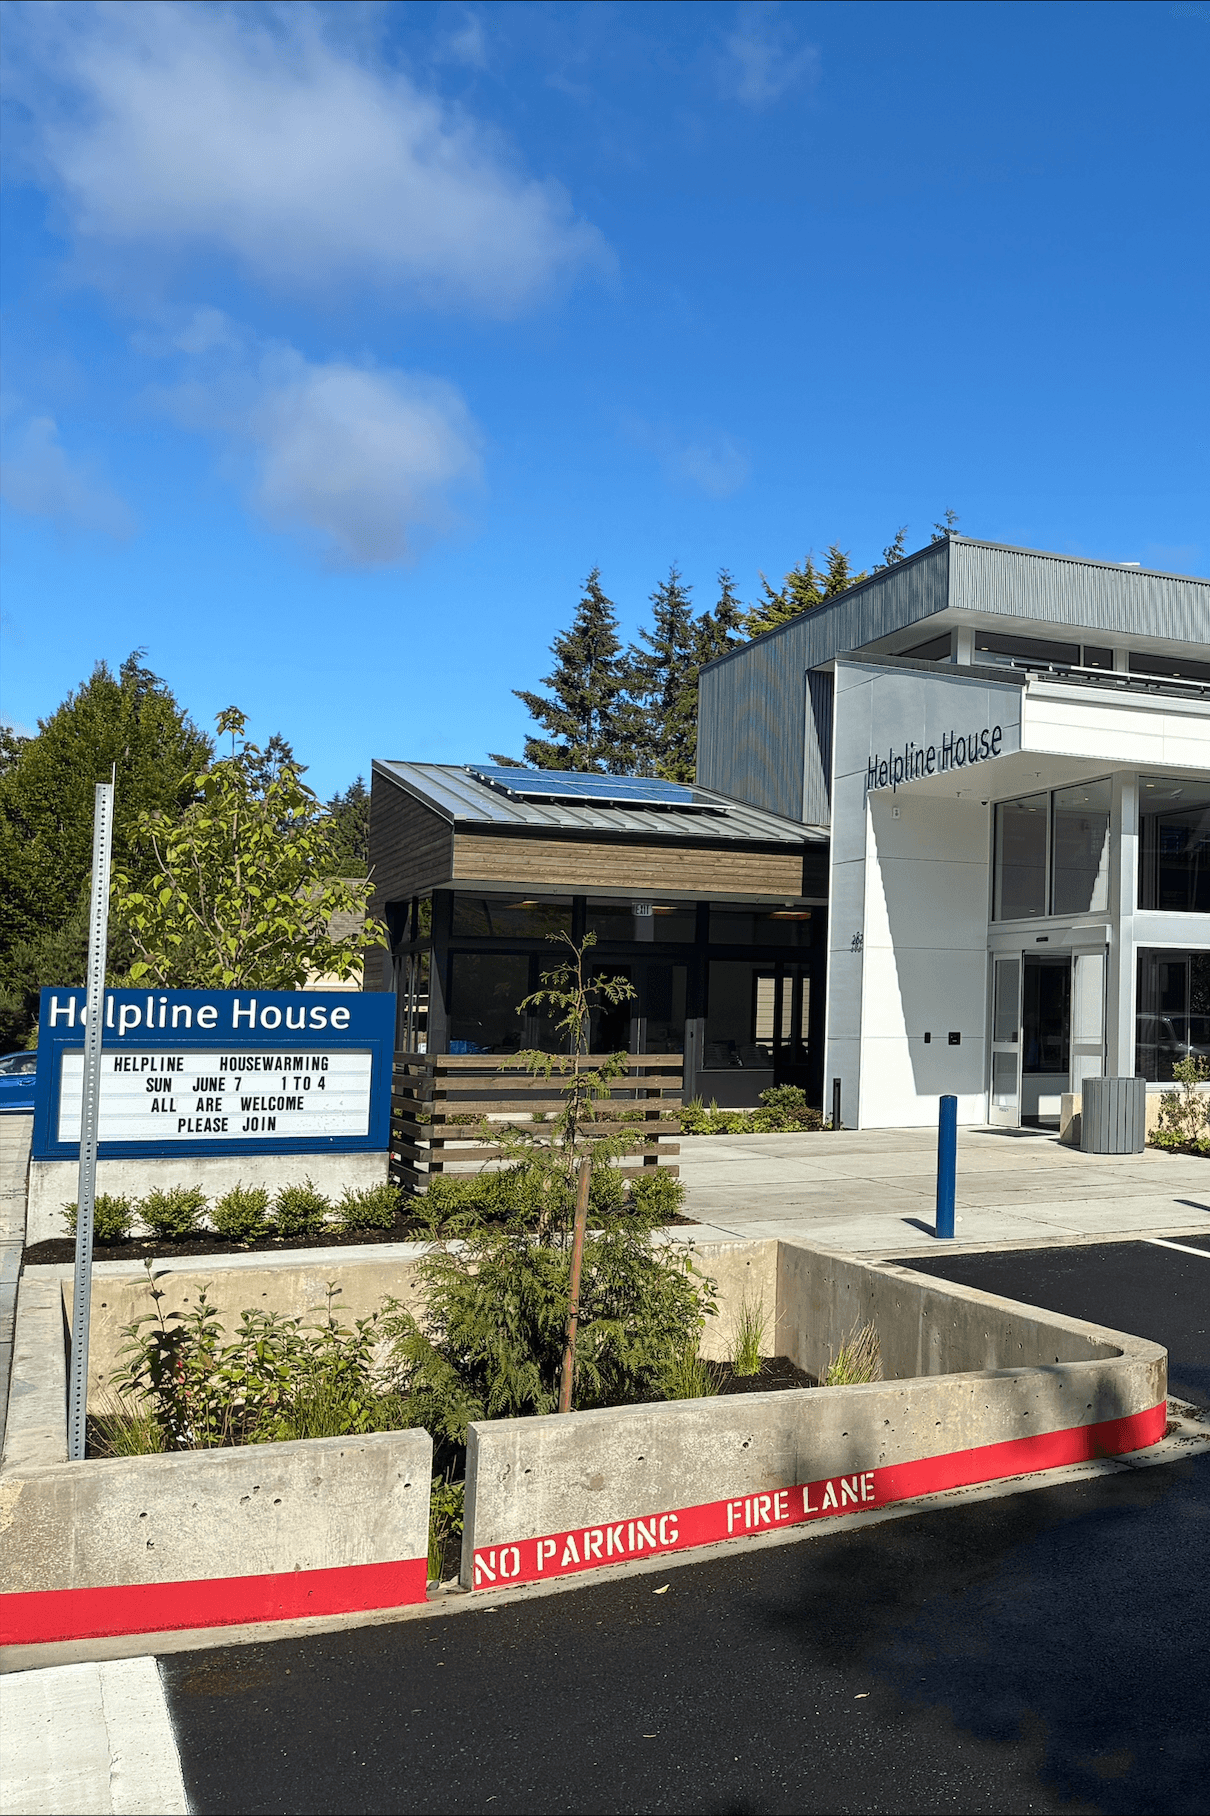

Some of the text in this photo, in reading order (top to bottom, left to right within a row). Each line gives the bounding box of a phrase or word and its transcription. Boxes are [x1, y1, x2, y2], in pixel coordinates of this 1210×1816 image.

[868, 725, 1002, 793] Helpline House
[635, 904, 650, 915] EXIT
[232, 998, 351, 1031] House
[114, 1056, 329, 1072] HELPLINE HOUSEWARMING
[145, 1076, 326, 1092] SUN JUNE 7 1 TO 4
[150, 1096, 304, 1113] ALL ARE WELCOME
[177, 1116, 276, 1133] PLEASE JOIN
[474, 1472, 876, 1585] NO PARKING FIRE LANE
